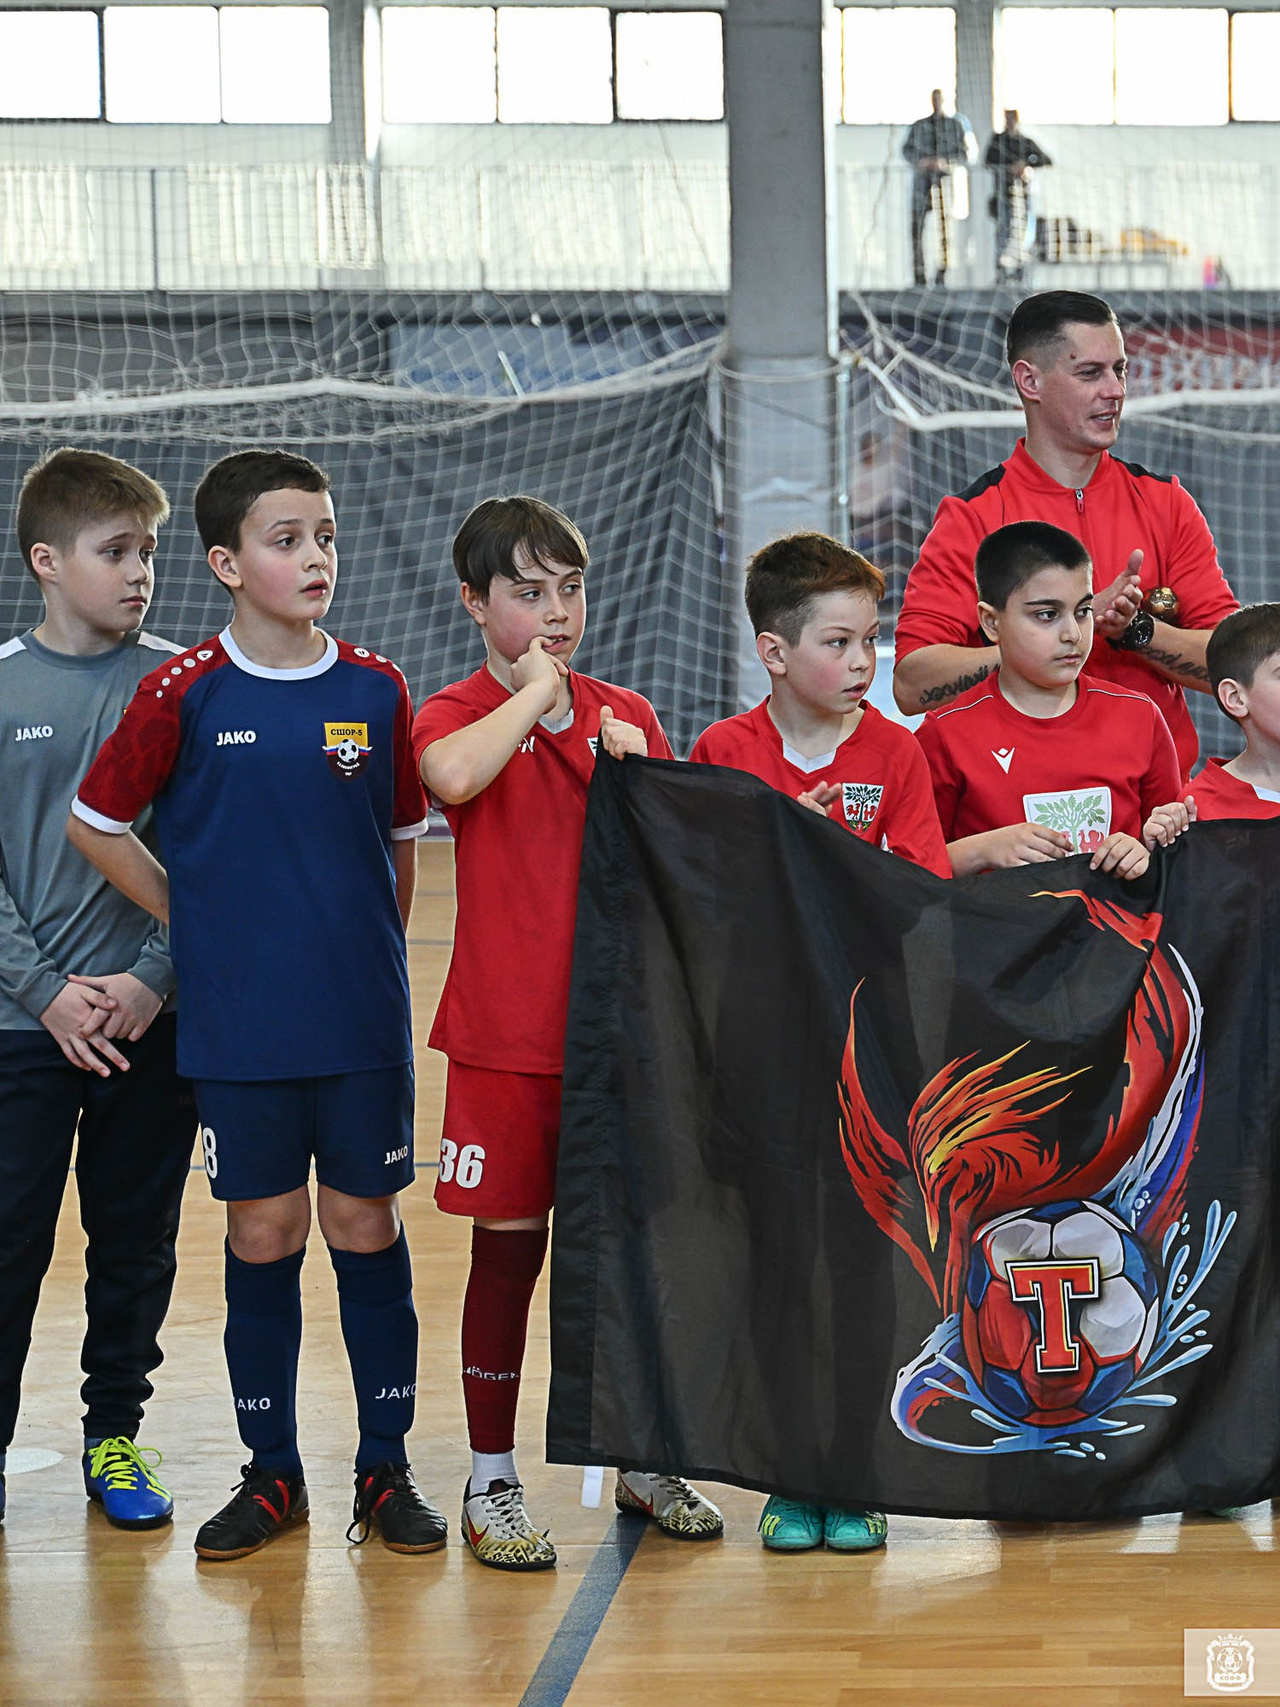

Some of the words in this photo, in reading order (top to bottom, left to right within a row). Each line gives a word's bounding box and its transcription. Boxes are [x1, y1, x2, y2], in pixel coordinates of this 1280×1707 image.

[15, 725, 54, 742] JAKO
[216, 730, 257, 746] JAKO
[330, 728, 363, 737] СШОР-5
[518, 735, 536, 754] N
[202, 1127, 218, 1179] 8
[384, 1144, 409, 1165] JAKO
[438, 1137, 487, 1190] 36
[375, 1382, 417, 1400] JAKO
[235, 1396, 271, 1411] AKO
